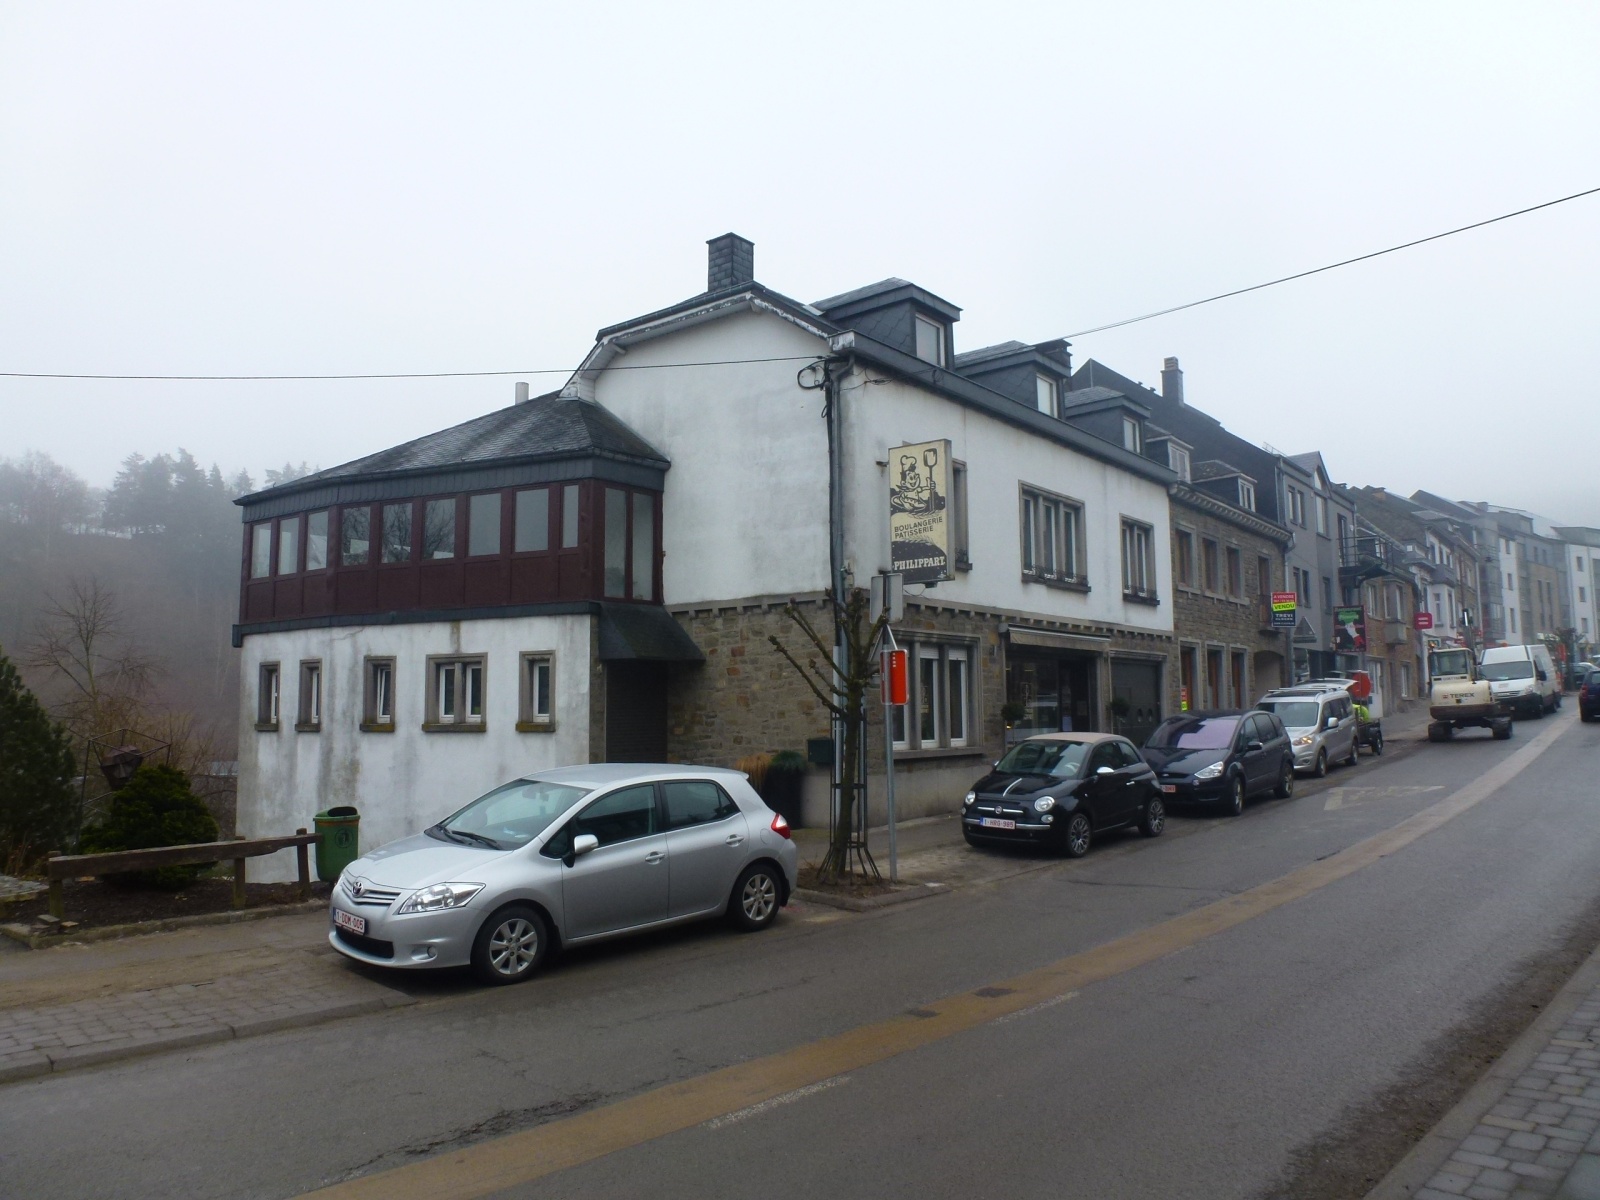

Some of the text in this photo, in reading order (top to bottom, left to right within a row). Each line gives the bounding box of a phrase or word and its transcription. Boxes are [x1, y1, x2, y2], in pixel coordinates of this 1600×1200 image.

[894, 516, 943, 533] BOULANGERIE
[895, 525, 934, 539] PATISSERIE
[894, 556, 945, 570] PHILIPPART
